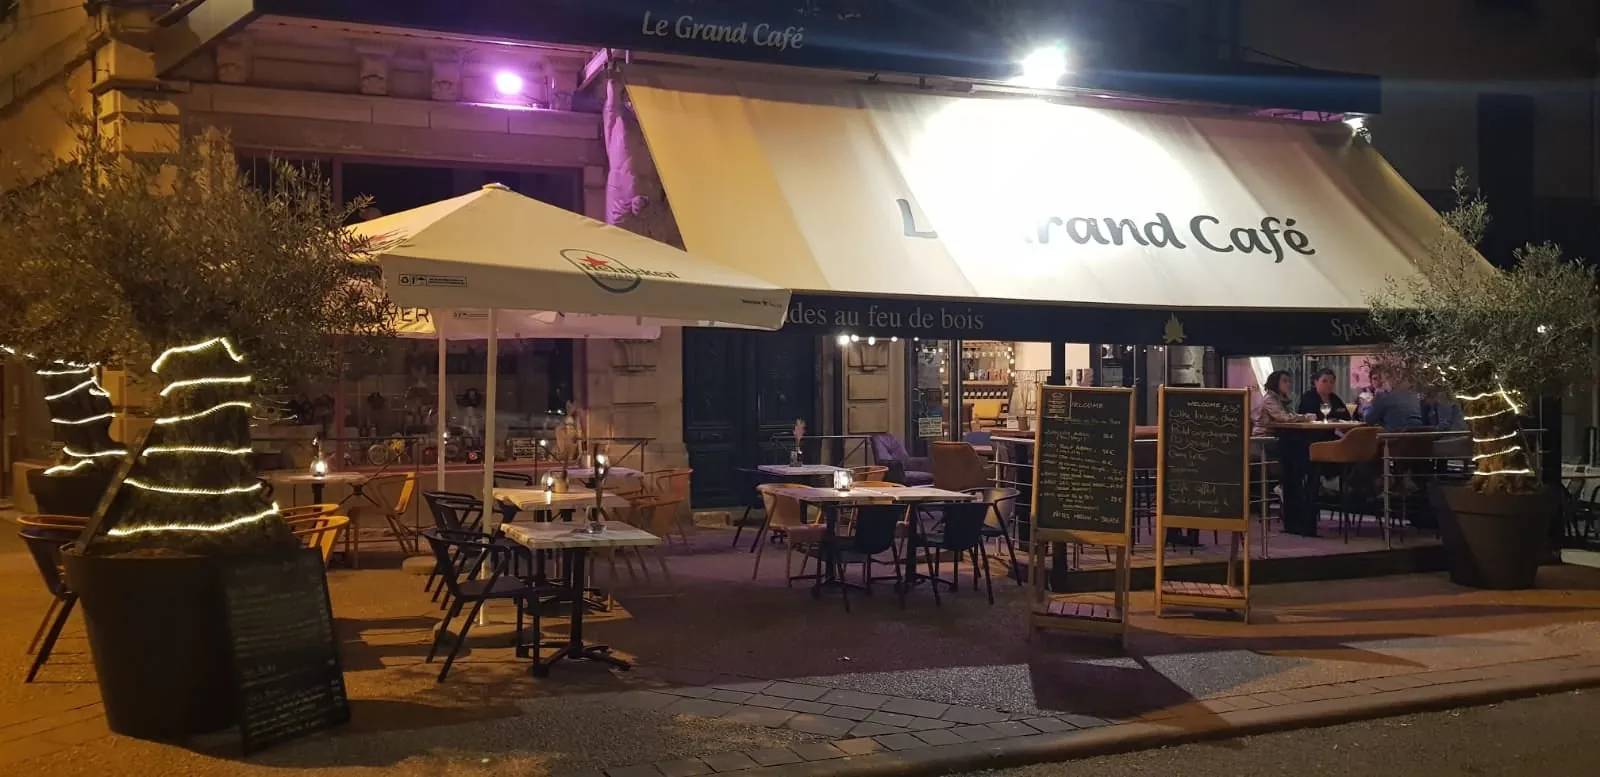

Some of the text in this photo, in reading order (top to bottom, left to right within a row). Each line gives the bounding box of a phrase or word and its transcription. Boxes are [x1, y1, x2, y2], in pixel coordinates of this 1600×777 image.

[642, 11, 804, 51] Le Grand Café
[1026, 212, 1187, 250] rand
[1188, 214, 1317, 264] Café
[834, 311, 860, 327] au
[867, 304, 902, 328] feu
[908, 307, 934, 329] de
[941, 306, 985, 331] bois
[1330, 318, 1375, 342] Spéc
